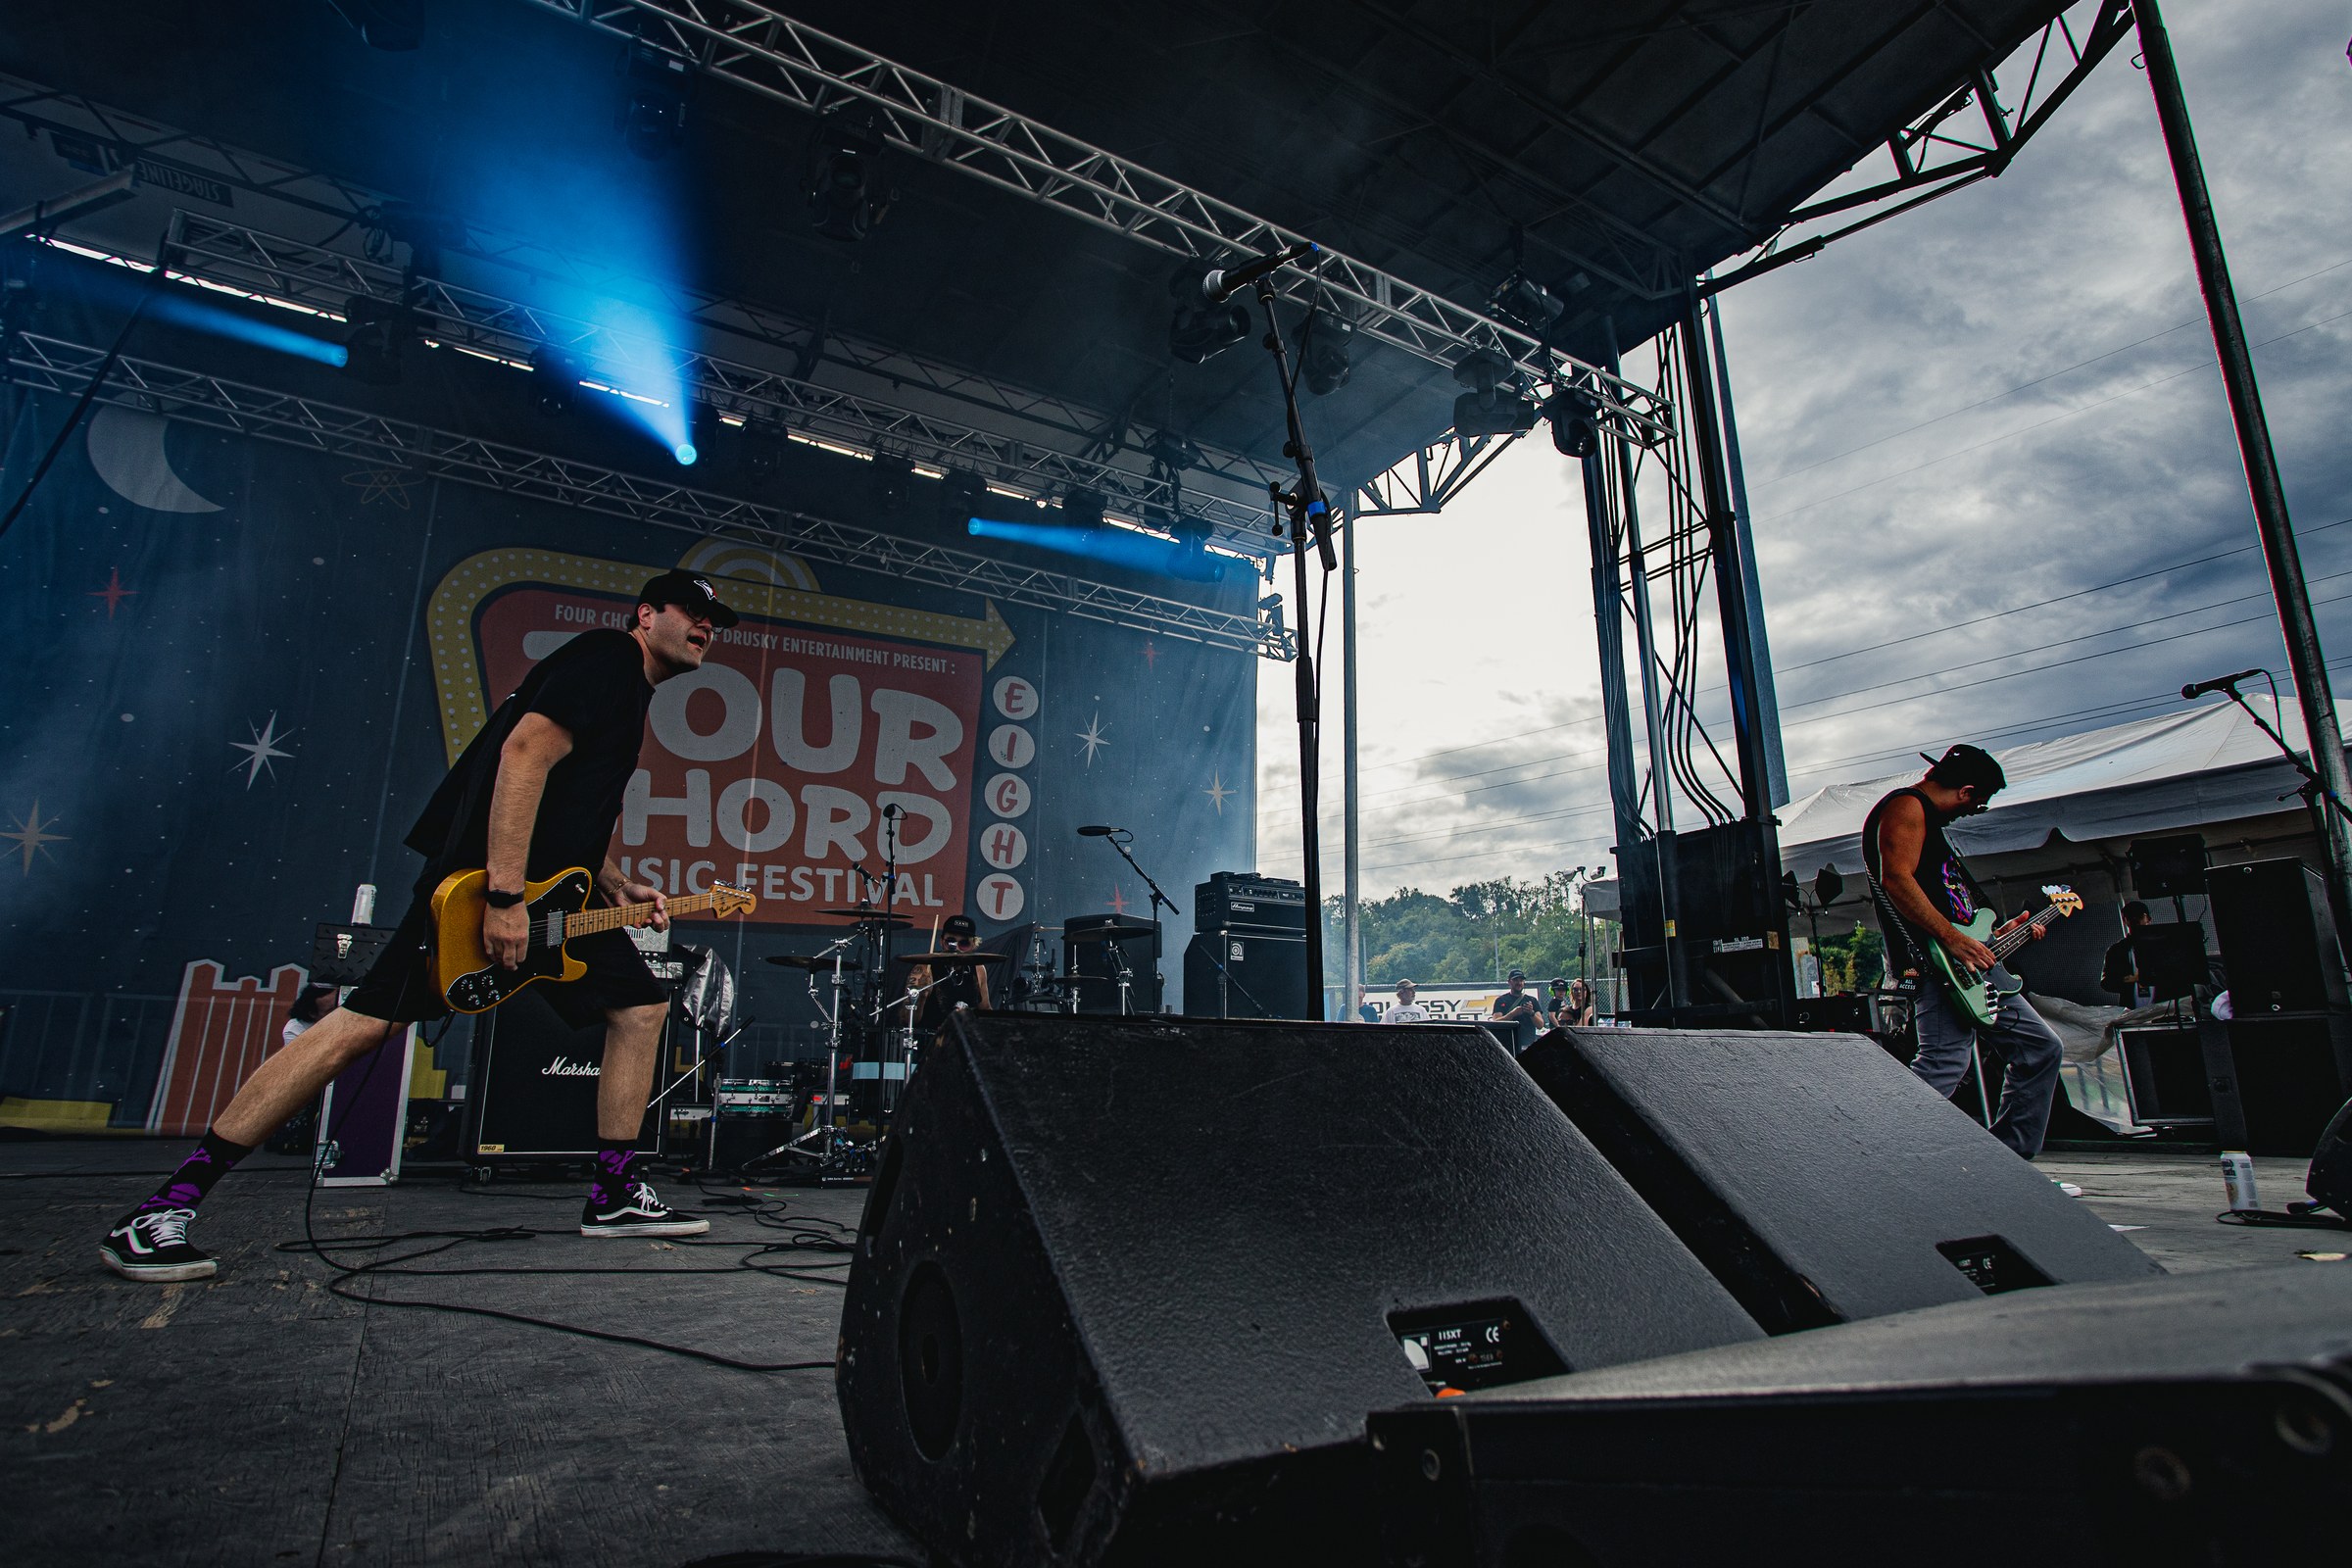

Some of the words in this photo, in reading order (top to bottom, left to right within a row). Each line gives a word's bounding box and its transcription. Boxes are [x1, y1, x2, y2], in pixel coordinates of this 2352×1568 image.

[137, 160, 220, 202] STAGELINE
[555, 604, 596, 626] FOUR
[602, 611, 631, 630] CHO
[723, 628, 779, 651] DRUSKY
[783, 637, 890, 665] ENTERTAINMENT
[893, 654, 948, 674] PRESENT
[522, 630, 964, 792] OUR
[612, 768, 953, 864] HORD
[620, 855, 716, 895] SIC
[736, 861, 944, 906] FESTIVAL
[541, 1055, 601, 1076] Marsha
